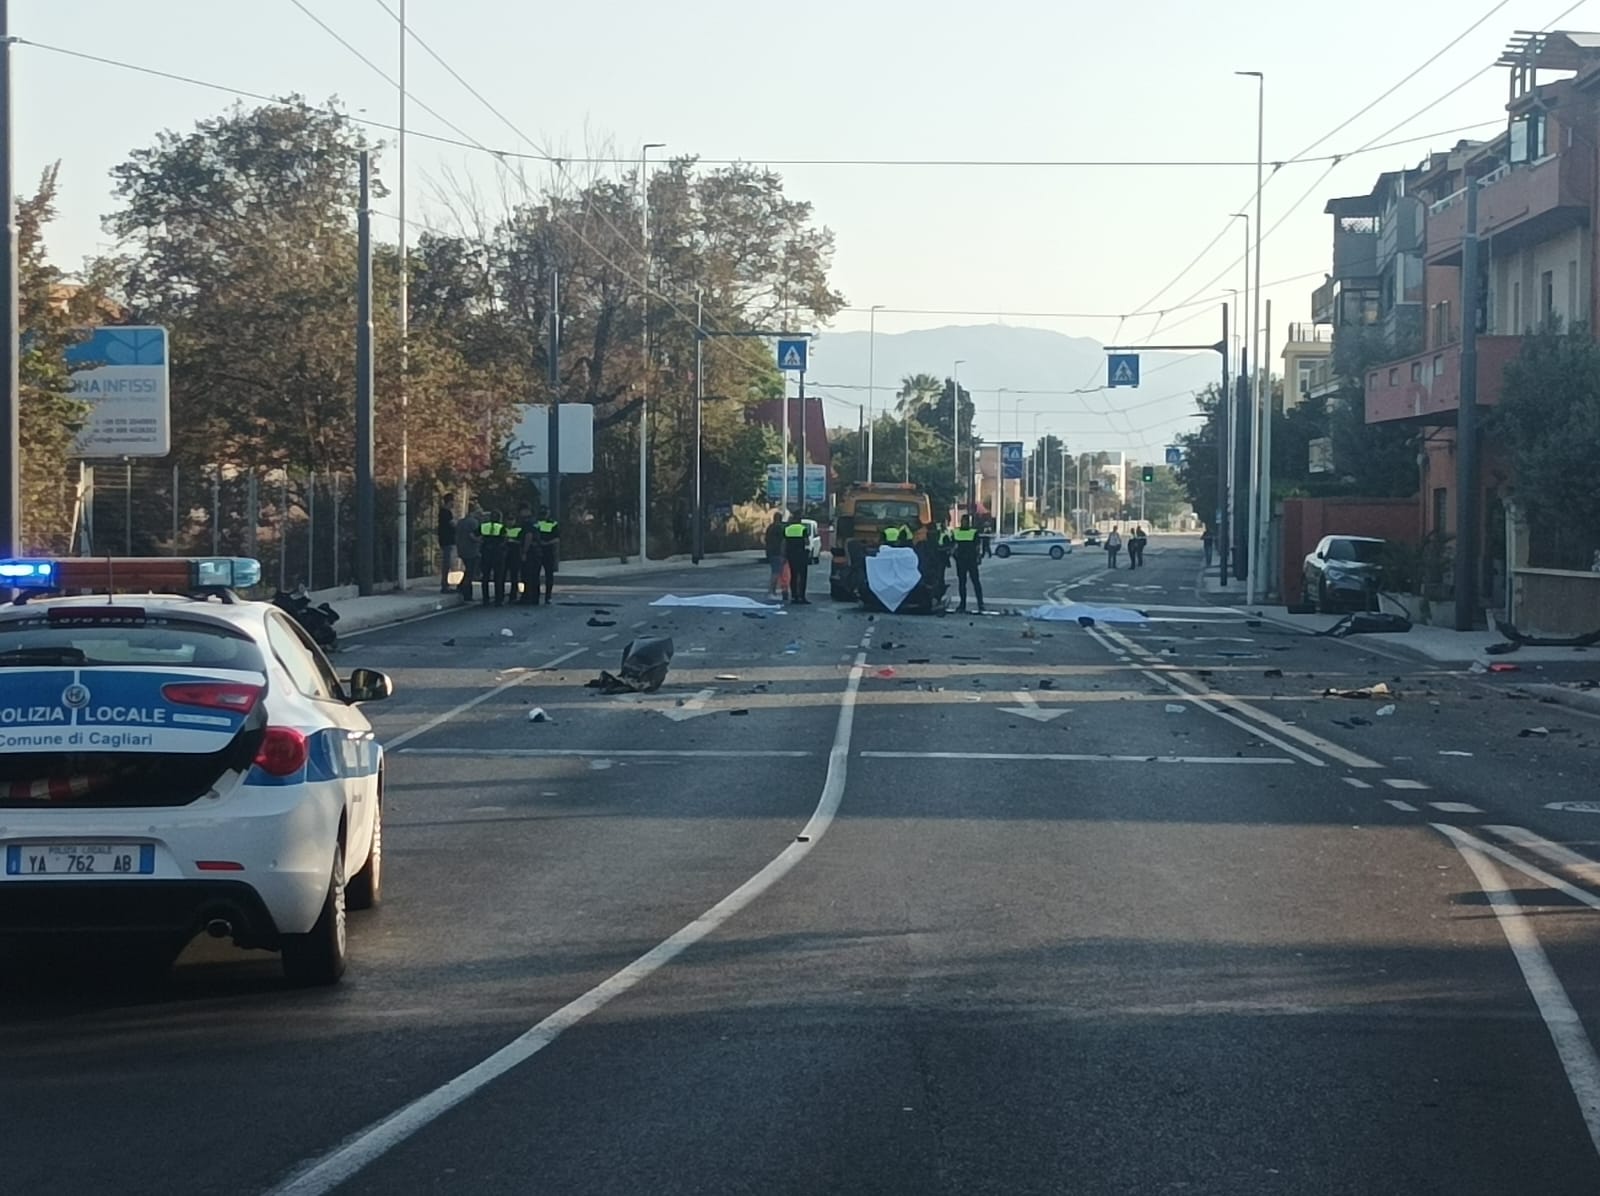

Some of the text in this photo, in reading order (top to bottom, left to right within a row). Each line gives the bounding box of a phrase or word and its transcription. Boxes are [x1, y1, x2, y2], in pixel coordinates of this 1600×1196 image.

[103, 379, 157, 393] INFISSI
[0, 707, 64, 723] OLIZIA
[85, 706, 166, 723] LOCALE
[68, 731, 83, 745] di
[89, 732, 153, 748] Cagliari
[29, 855, 132, 872] YA 762 AB
